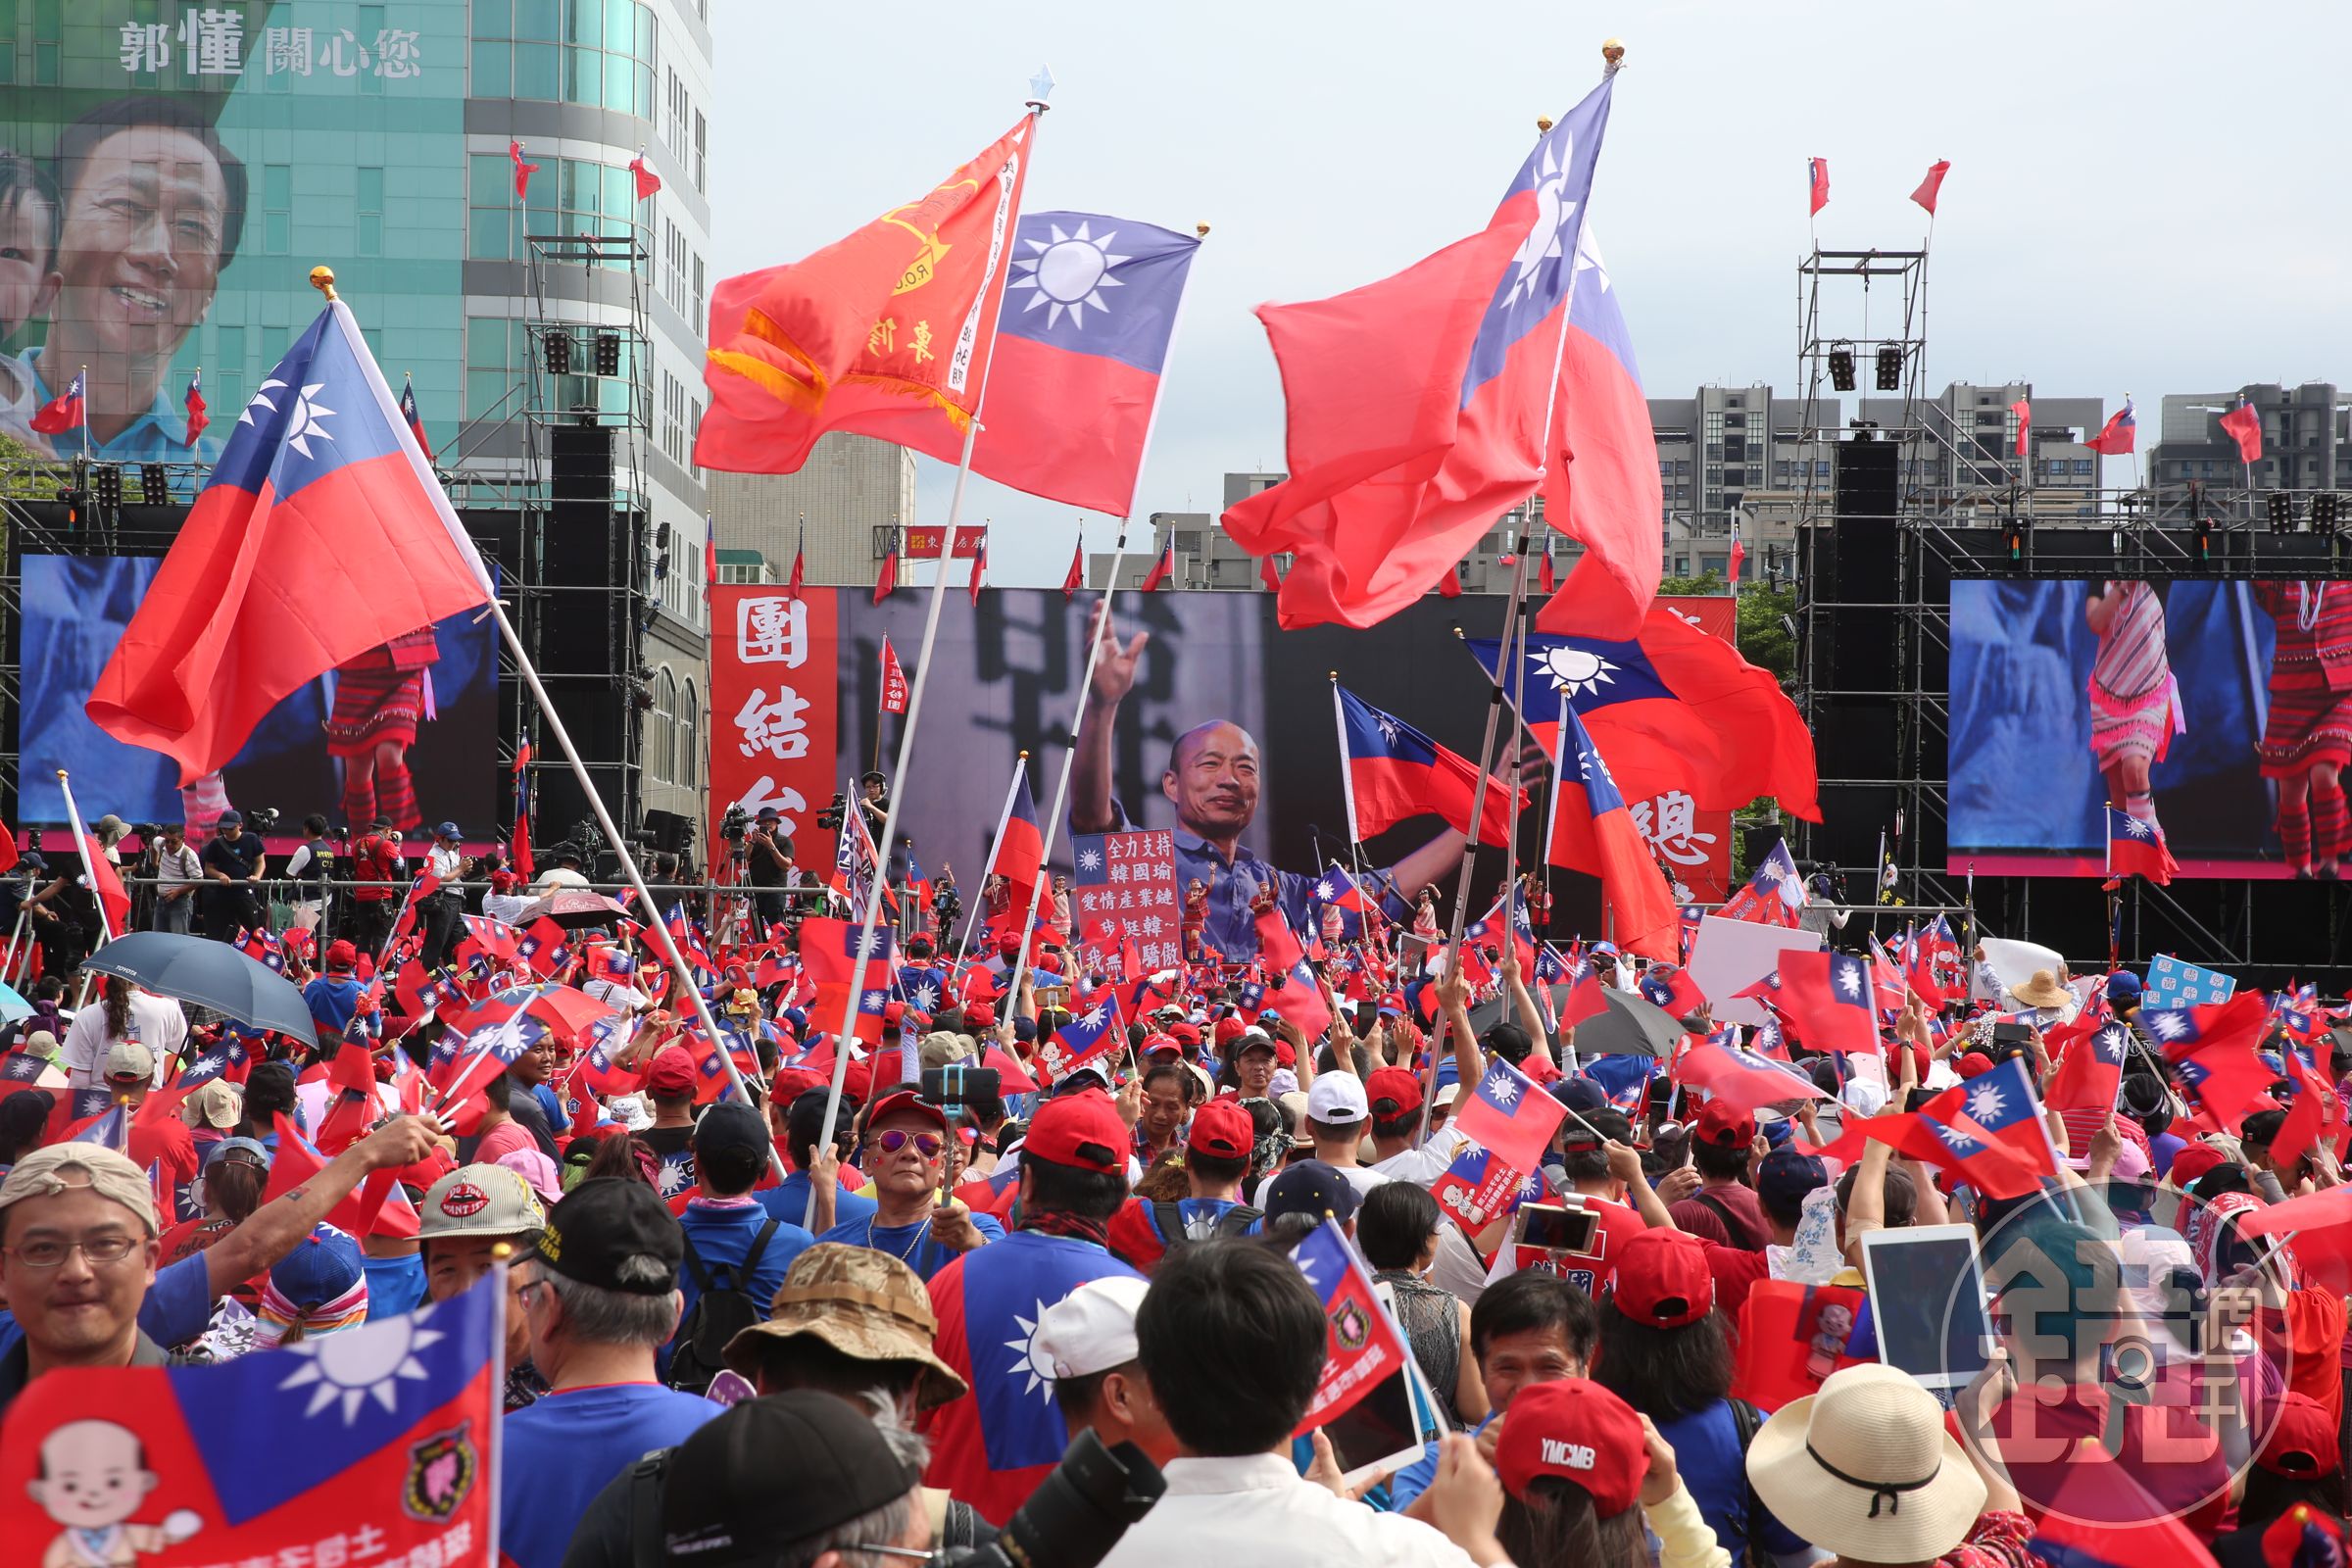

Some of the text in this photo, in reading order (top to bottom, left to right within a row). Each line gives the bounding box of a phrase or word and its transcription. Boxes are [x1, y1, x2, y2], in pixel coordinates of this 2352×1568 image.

[120, 8, 420, 78] 郭懂 關心您
[927, 535, 982, 549] 東房屋
[735, 596, 811, 897] 團結台
[1107, 833, 1172, 859] 全力支持
[1110, 860, 1173, 883] 韓國瑜
[1081, 887, 1174, 911] 愛情產業鏈
[1086, 941, 1181, 973] 我無驕傲
[116, 964, 137, 977] TOYOTA
[443, 1203, 469, 1215] WANT
[1541, 1437, 1596, 1470] YMCMB
